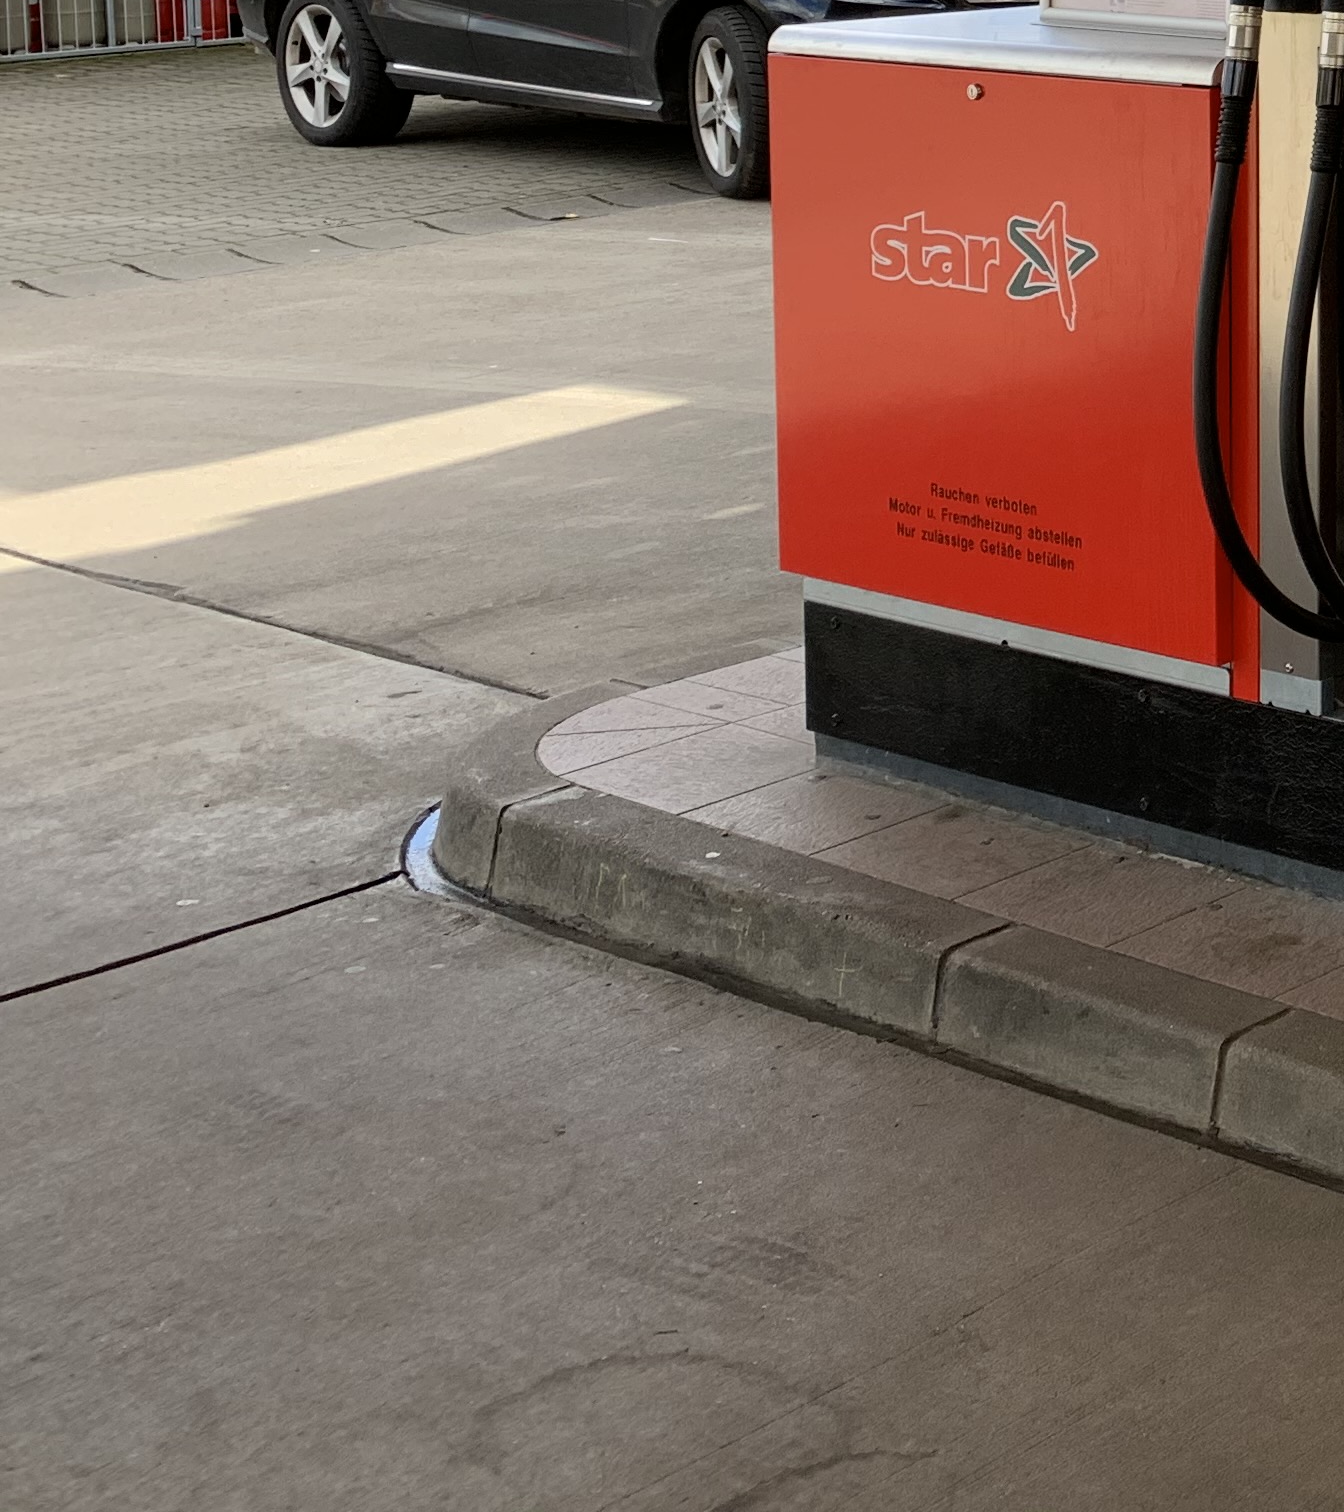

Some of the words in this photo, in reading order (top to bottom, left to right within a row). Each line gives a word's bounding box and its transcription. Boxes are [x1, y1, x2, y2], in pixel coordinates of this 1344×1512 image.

[870, 211, 999, 293] star
[889, 497, 921, 516] Motor
[927, 507, 936, 520] u.
[941, 508, 1022, 539] Fremdheizung
[1028, 527, 1082, 549] abstellen
[930, 483, 980, 504] Rauchen
[985, 494, 1037, 515] verboten
[896, 522, 915, 538] Nur
[921, 528, 974, 552] zulässige
[980, 539, 1022, 560] Gefäße
[1027, 549, 1074, 571] befüllen
